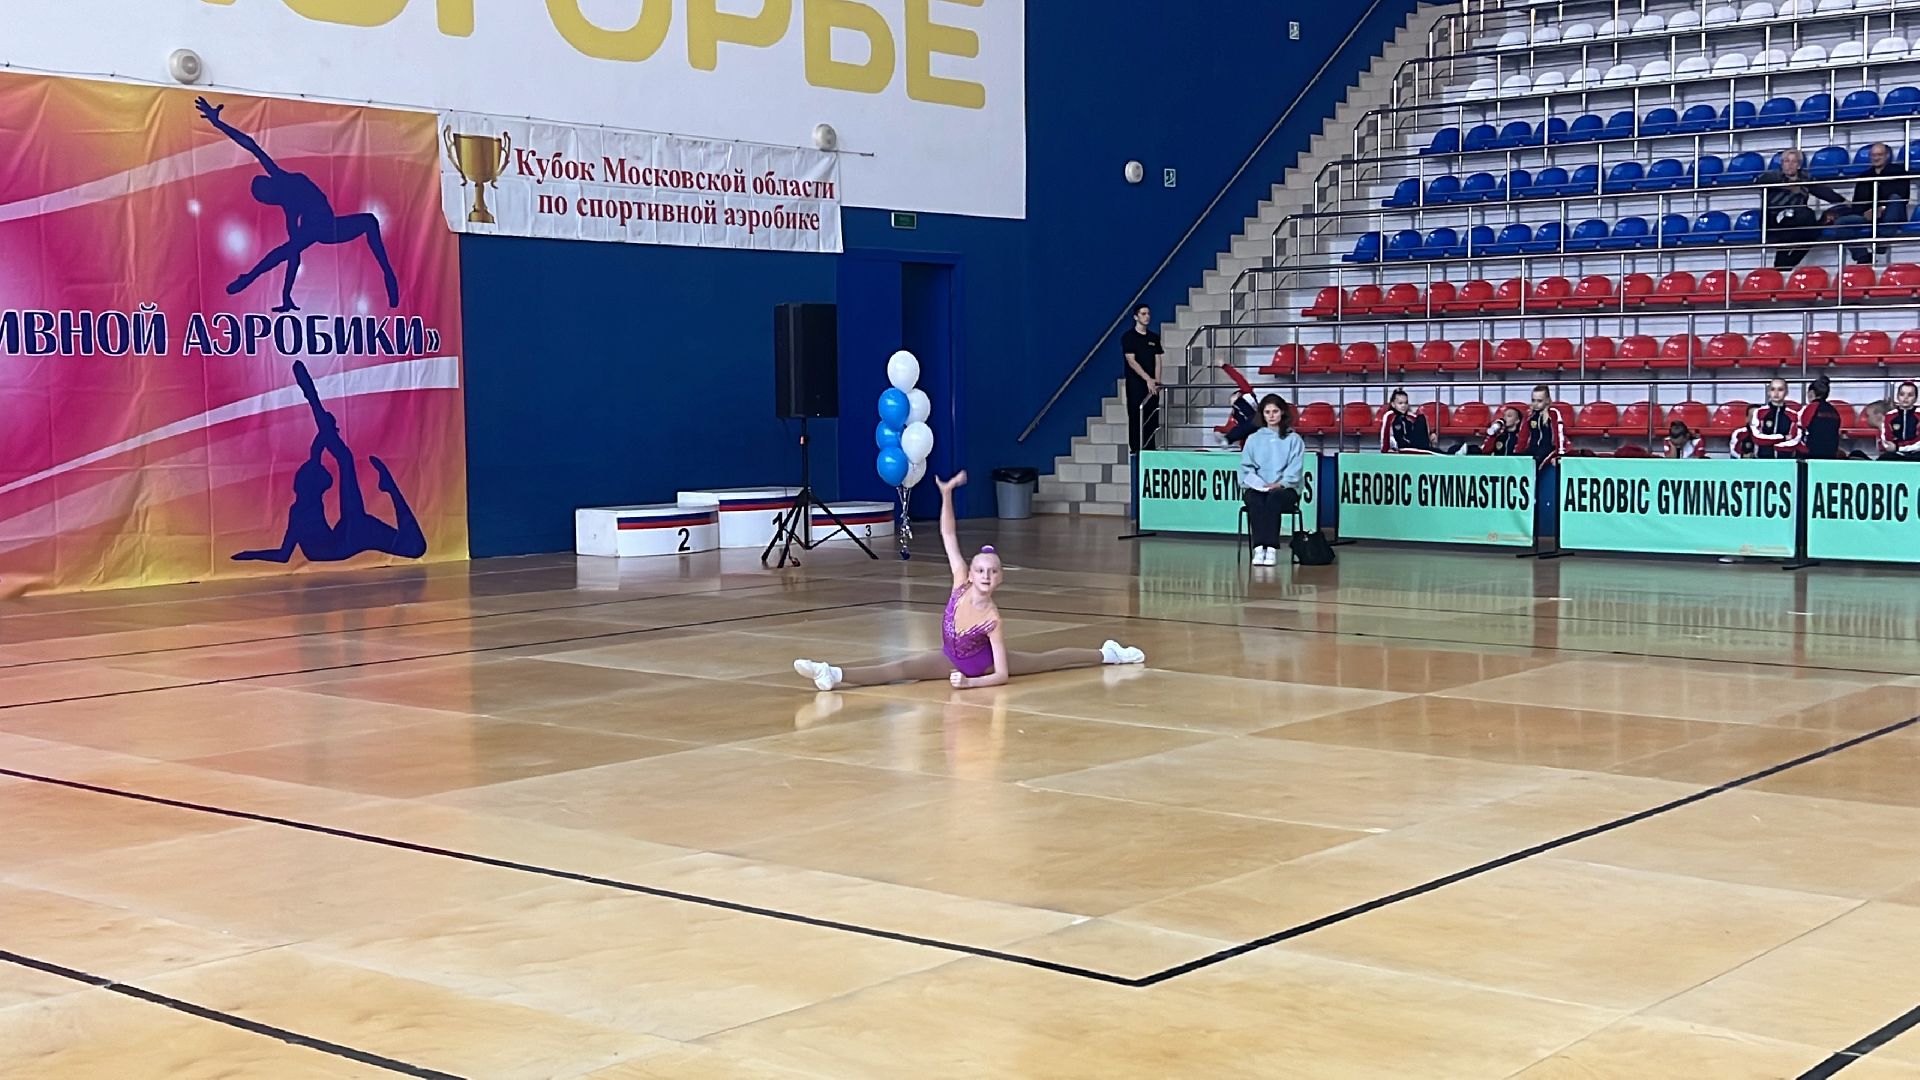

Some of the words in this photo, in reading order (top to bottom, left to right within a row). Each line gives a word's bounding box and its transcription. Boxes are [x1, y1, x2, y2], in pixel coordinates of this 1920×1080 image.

[514, 148, 595, 184] Кубок
[602, 156, 746, 192] Московской
[752, 170, 835, 199] области
[538, 194, 568, 216] по
[576, 197, 717, 227] спортивной
[724, 207, 820, 234] аэробике
[183, 313, 440, 356] АЭРОБИКИ»
[1142, 468, 1207, 500] AEROBIC
[1341, 472, 1412, 506] AEROBIC
[1418, 474, 1529, 511] GYMNASTICS
[1564, 478, 1649, 515] AEROBIC
[1657, 480, 1792, 519] GYMNASTICS
[1812, 482, 1908, 522] AEROBIC
[678, 528, 690, 551] 2
[865, 525, 871, 537] 3
